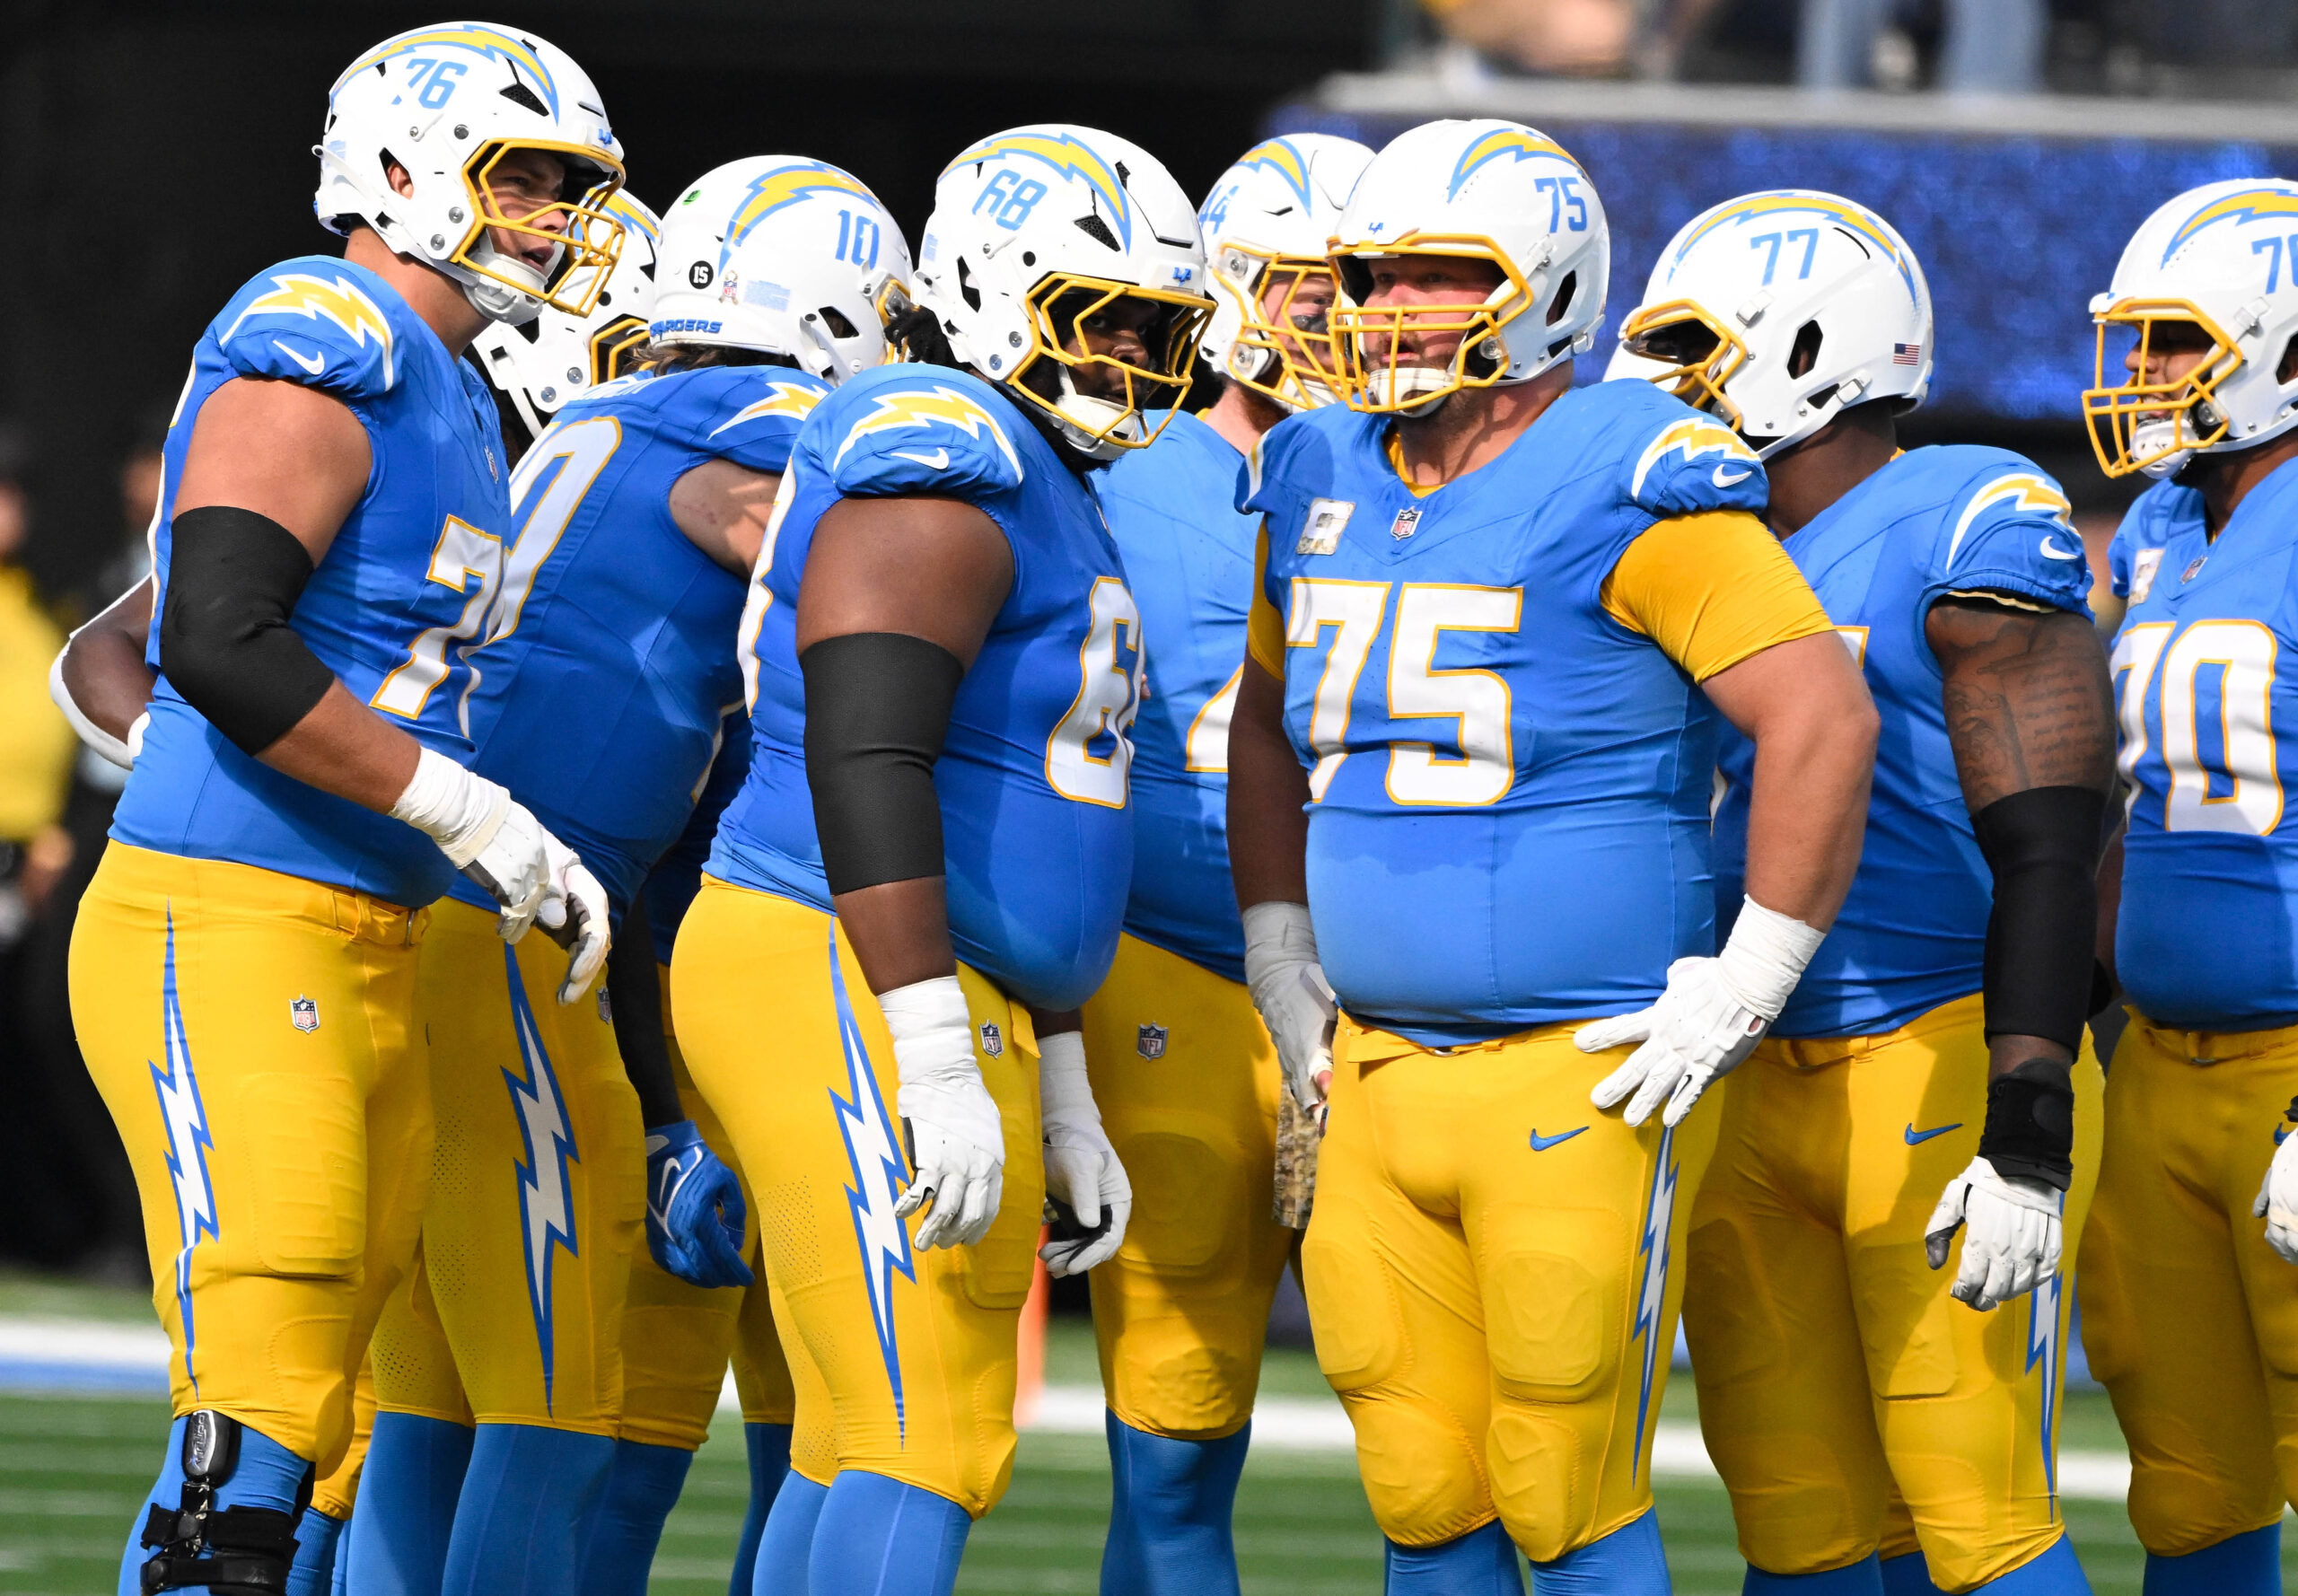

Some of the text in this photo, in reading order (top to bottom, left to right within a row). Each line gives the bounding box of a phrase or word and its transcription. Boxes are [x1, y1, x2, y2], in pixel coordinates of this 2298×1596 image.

[391, 58, 469, 110] 76
[972, 169, 1048, 231] 68
[1534, 177, 1587, 233] 75
[835, 209, 880, 270] 10
[1750, 228, 1820, 286] 77
[369, 513, 510, 740] 7
[1045, 575, 1145, 810] 6
[1285, 577, 1524, 807] 75
[2110, 619, 2285, 837] 70
